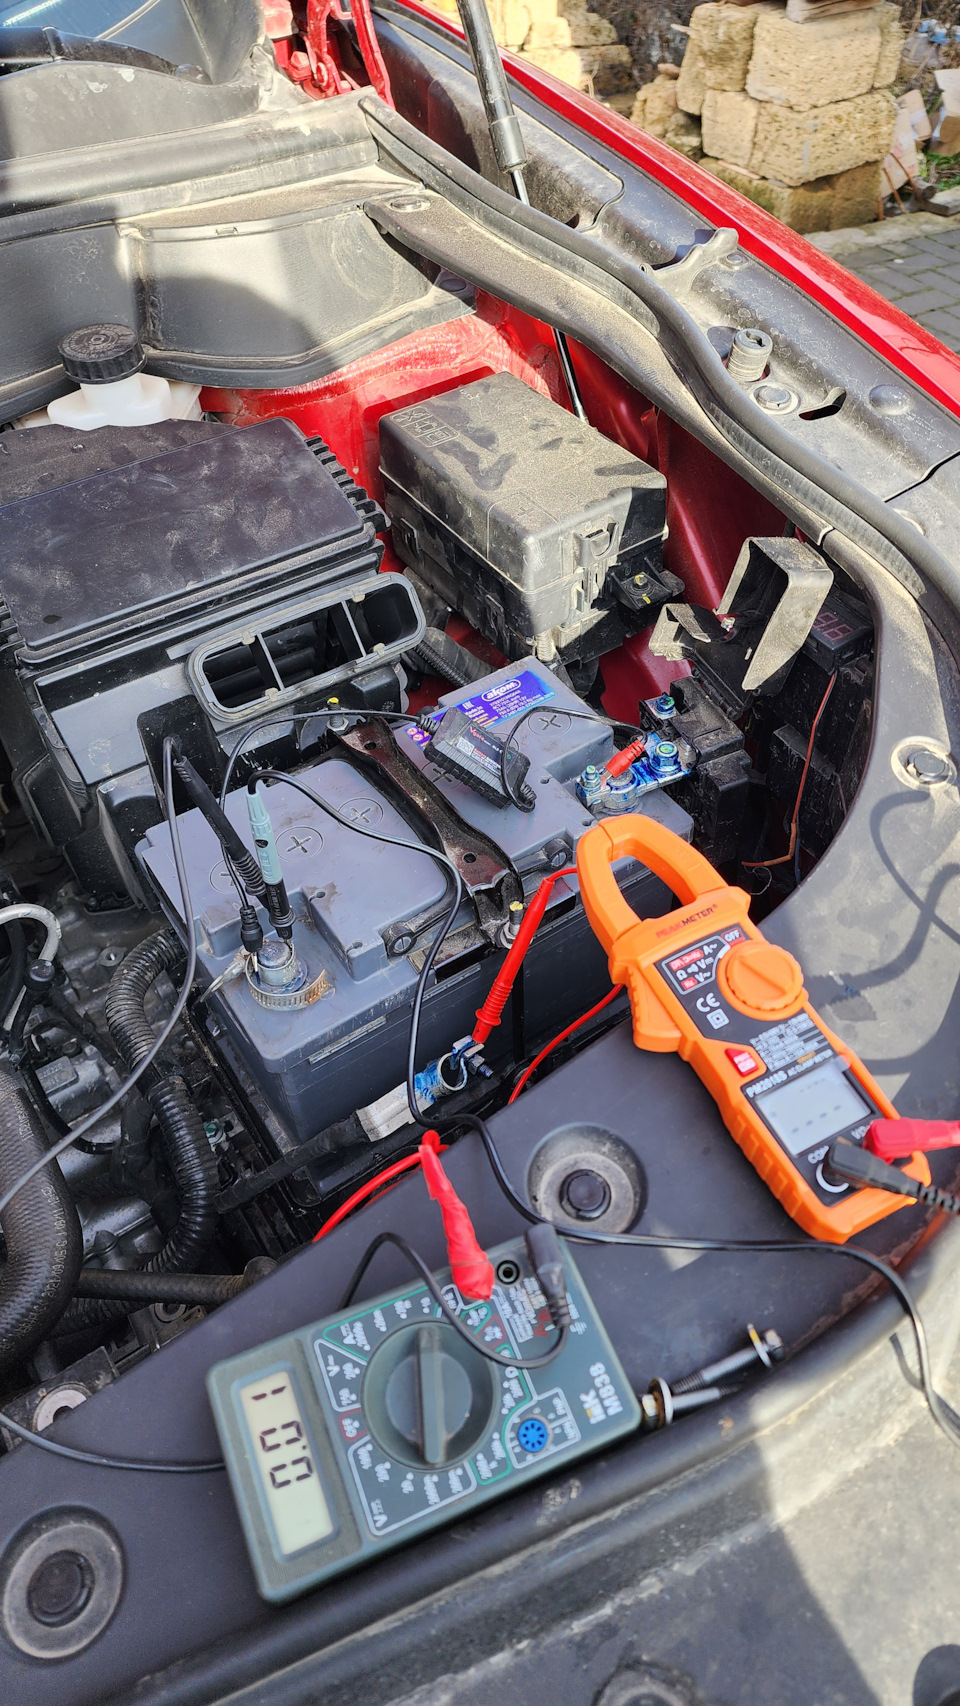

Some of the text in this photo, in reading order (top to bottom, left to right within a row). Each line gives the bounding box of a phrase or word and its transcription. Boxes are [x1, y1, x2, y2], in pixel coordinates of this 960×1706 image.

[723, 929, 740, 942] OFF
[696, 992, 721, 1012] CE
[588, 1360, 623, 1416] M838
[249, 1384, 314, 1489] 0.01
[341, 1416, 357, 1437] OFF
